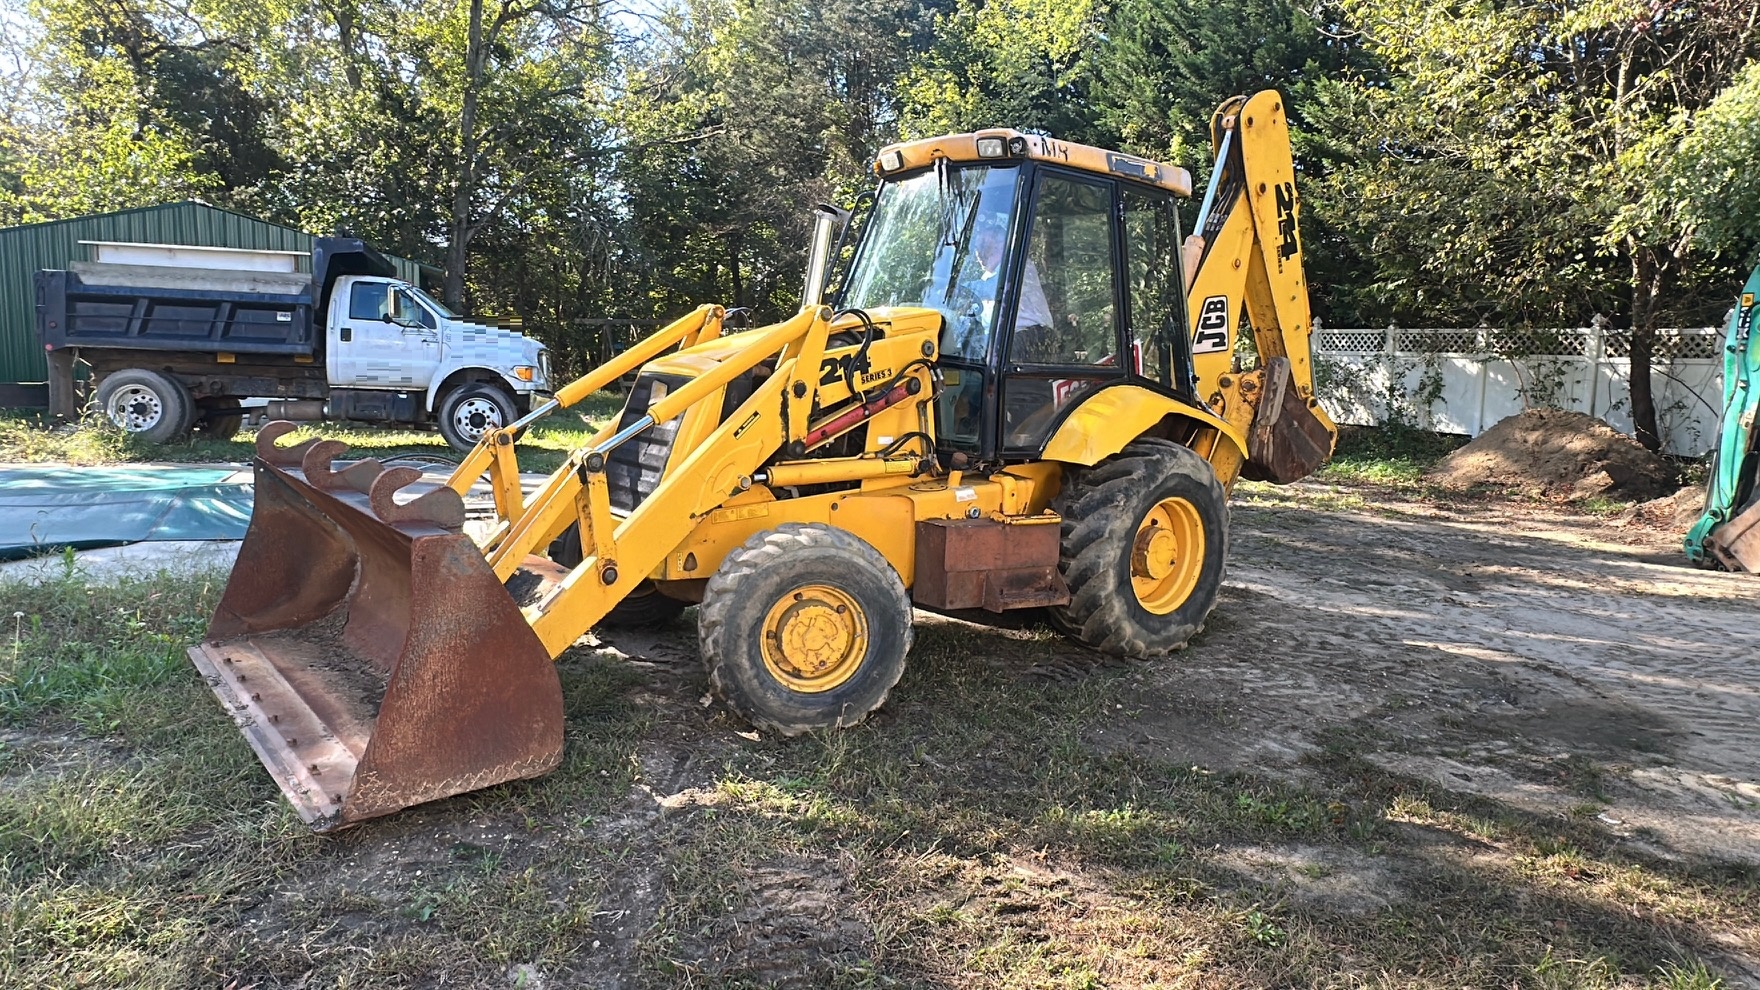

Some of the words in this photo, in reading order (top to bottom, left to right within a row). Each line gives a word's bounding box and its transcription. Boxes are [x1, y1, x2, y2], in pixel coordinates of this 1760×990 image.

[1275, 182, 1298, 261] 214
[1196, 299, 1226, 348] JCB
[819, 349, 871, 386] 214
[861, 370, 886, 384] SERIES
[887, 368, 893, 377] 3
